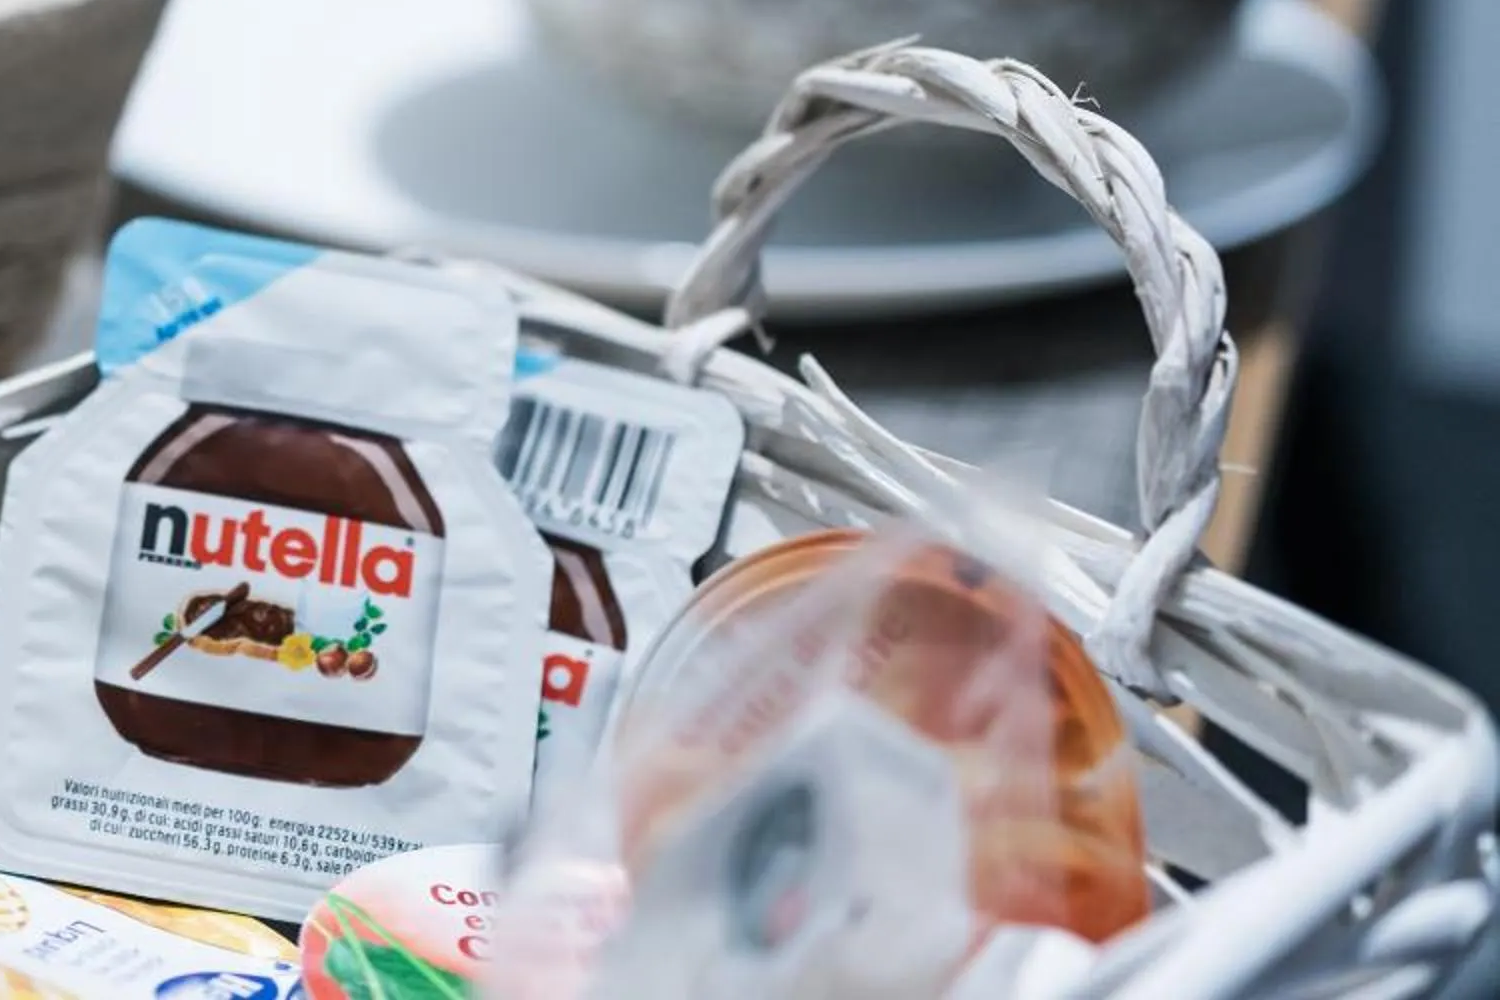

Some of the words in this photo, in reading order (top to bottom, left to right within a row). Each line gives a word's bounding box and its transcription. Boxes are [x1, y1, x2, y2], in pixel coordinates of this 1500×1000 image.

[139, 503, 414, 598] nutella
[51, 795, 88, 813] grassi
[135, 809, 146, 823] di
[173, 817, 203, 834] acidi
[205, 823, 242, 841] grassi
[244, 830, 280, 847] saturi
[65, 779, 99, 797] Valori
[172, 800, 201, 816] medi
[203, 806, 223, 820] per
[269, 817, 315, 838] energia
[89, 818, 101, 833] di
[128, 826, 181, 847] zuccheri
[227, 842, 278, 864] proteine
[317, 858, 341, 876] sale
